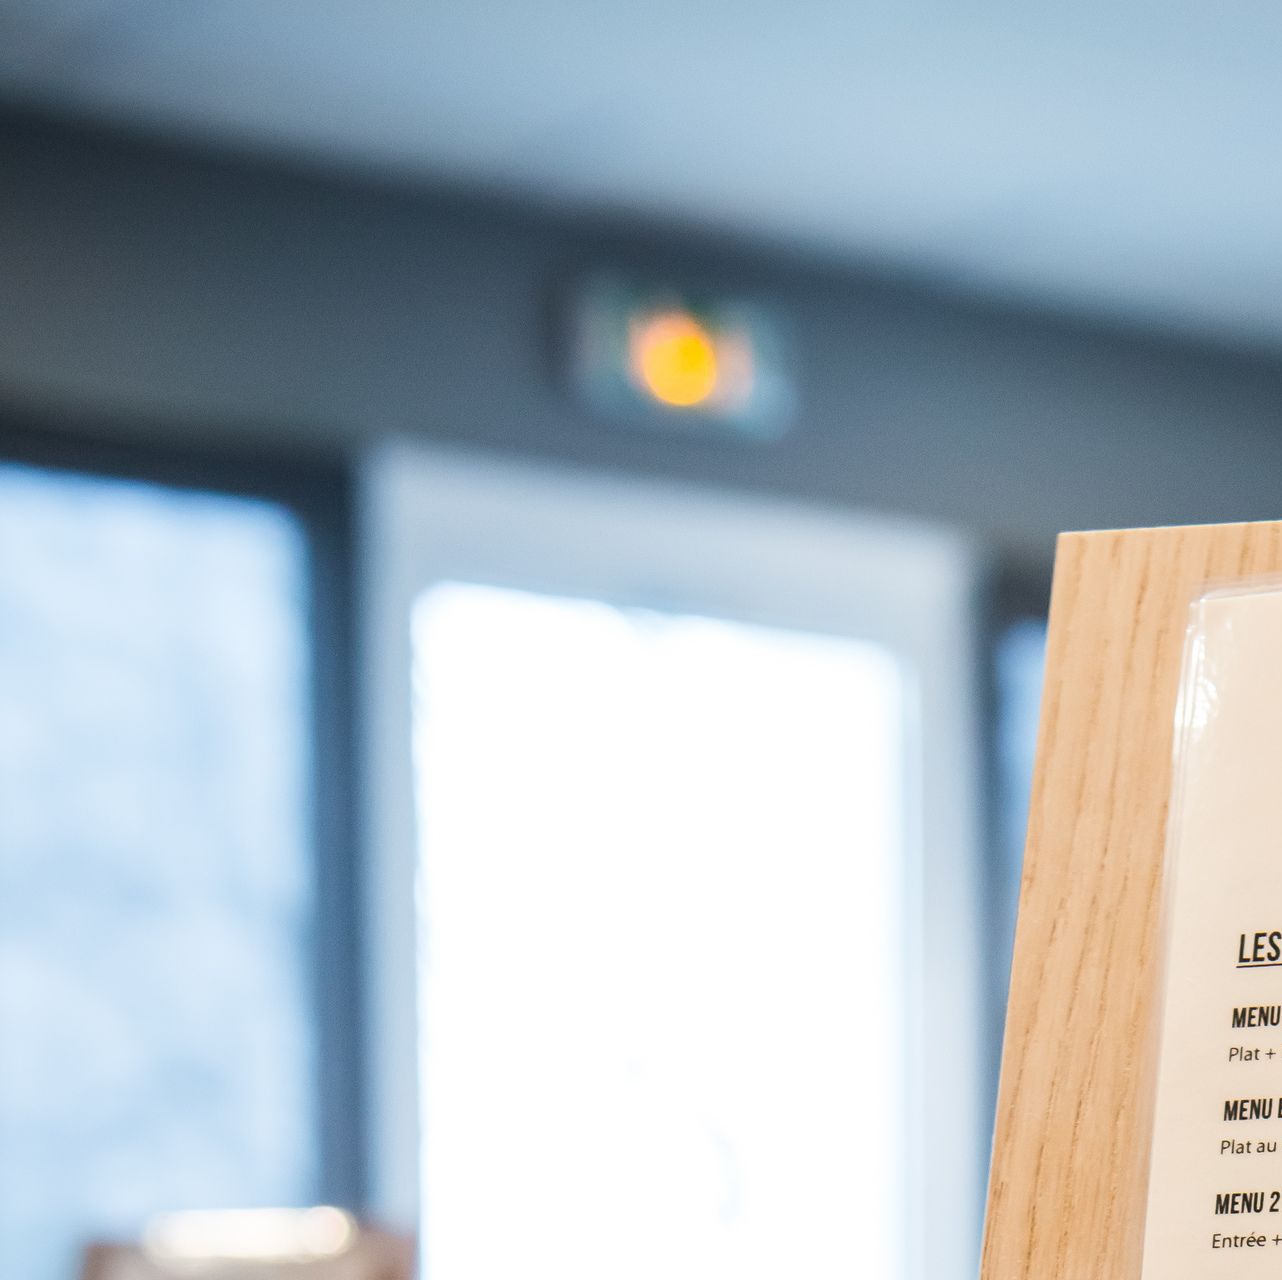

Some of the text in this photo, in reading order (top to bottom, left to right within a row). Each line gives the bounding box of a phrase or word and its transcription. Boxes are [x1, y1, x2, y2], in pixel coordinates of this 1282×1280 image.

[1238, 930, 1282, 963] LES
[1231, 1006, 1281, 1028] MENU
[1228, 1046, 1260, 1062] Plat
[1223, 1099, 1272, 1121] MENU
[1220, 1139, 1251, 1155] Plat
[1256, 1140, 1277, 1154] au
[1215, 1192, 1265, 1215] MENU
[1269, 1191, 1280, 1213] 2
[1211, 1231, 1267, 1249] Entrée
